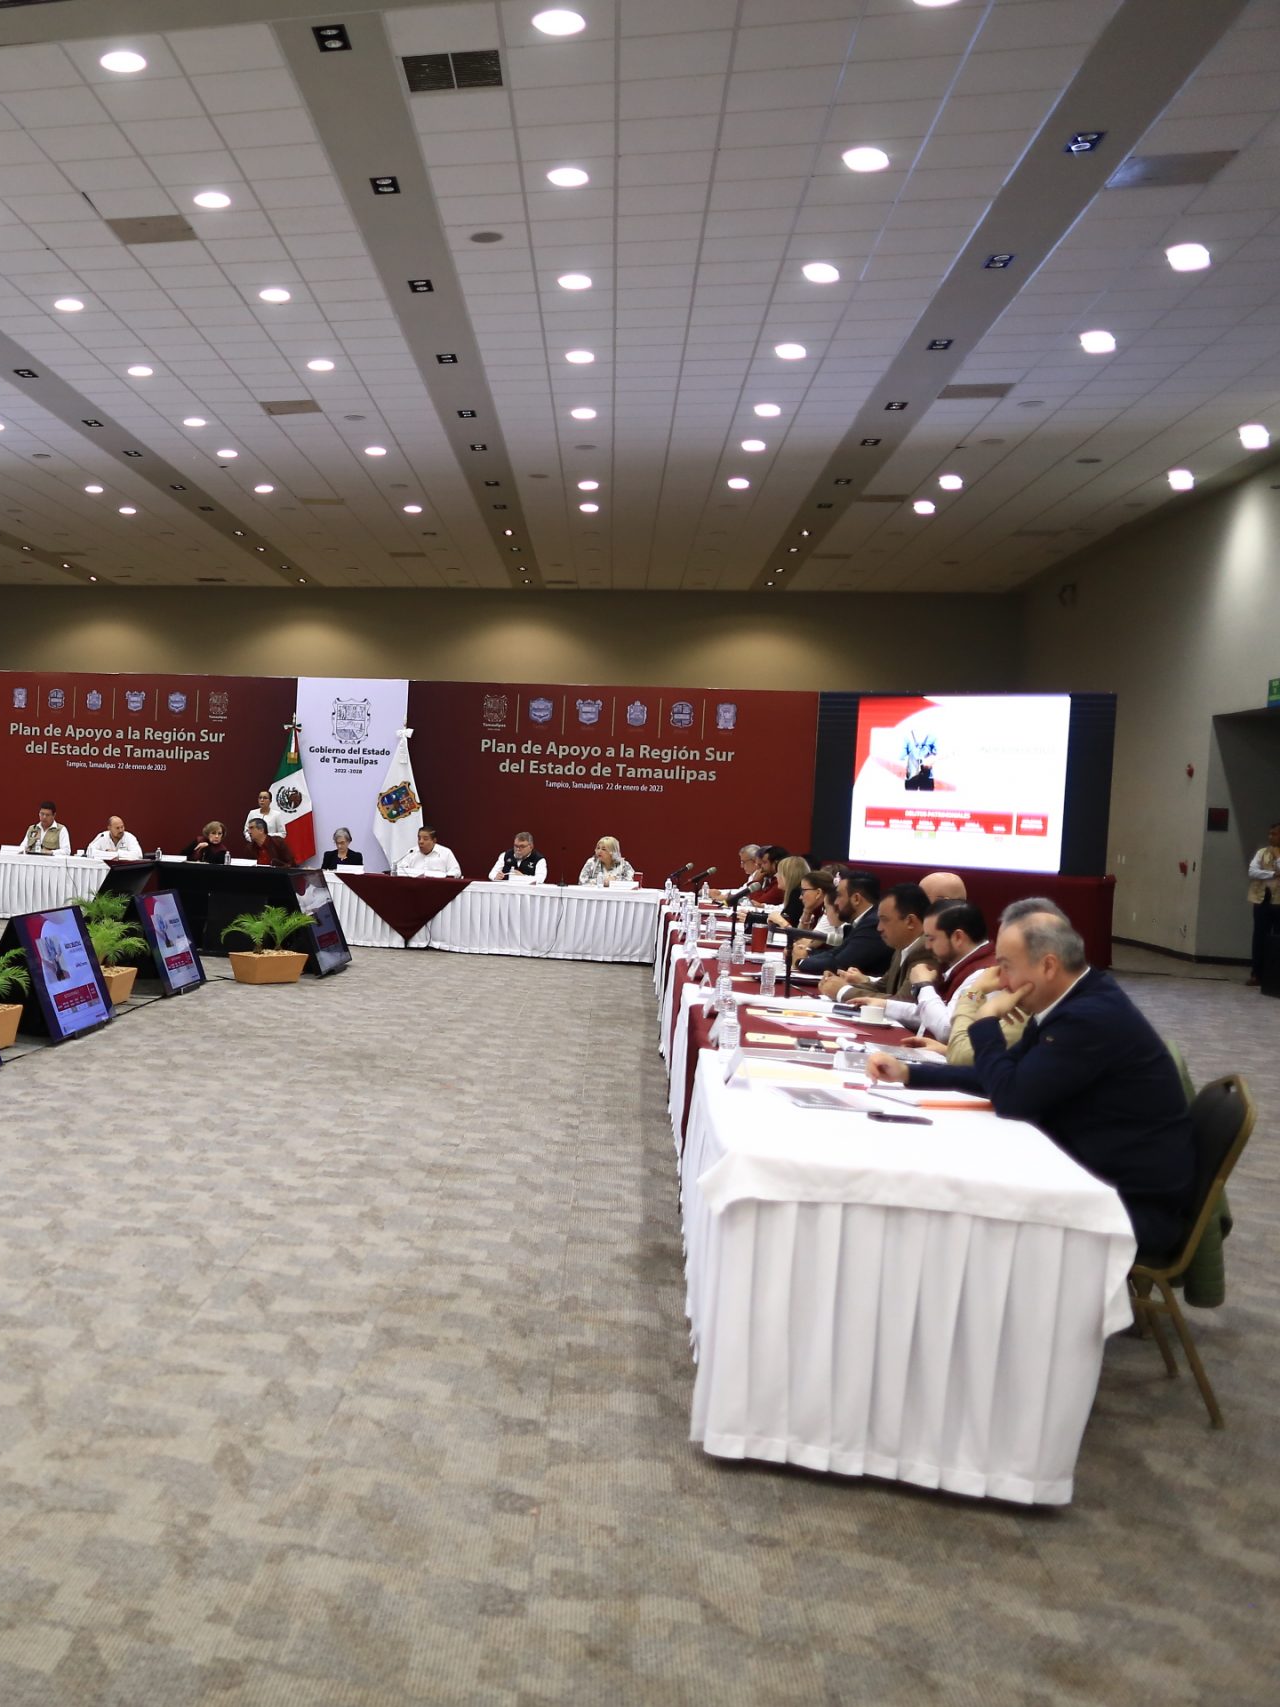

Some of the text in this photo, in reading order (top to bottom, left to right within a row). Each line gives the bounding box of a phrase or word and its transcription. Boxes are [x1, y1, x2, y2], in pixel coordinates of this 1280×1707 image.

[9, 722, 225, 744] Plan de Apoyo a la Región Sur
[25, 740, 210, 763] del Estado de Tamaulipas
[308, 745, 391, 756] Gobierno del Estado
[481, 738, 735, 763] Plan de Apoyo a la Región Sur
[66, 760, 88, 769] Tampico,
[89, 761, 116, 770] Tamaulipas
[319, 755, 379, 766] de Tamaulipas
[499, 758, 717, 784] del Estado de Tamaulipas
[545, 780, 571, 789] Tampico,
[571, 780, 604, 790] Tamaulipas
[606, 782, 614, 790] 22
[614, 782, 622, 791] de
[640, 783, 648, 792] de
[648, 784, 664, 792] 2023
